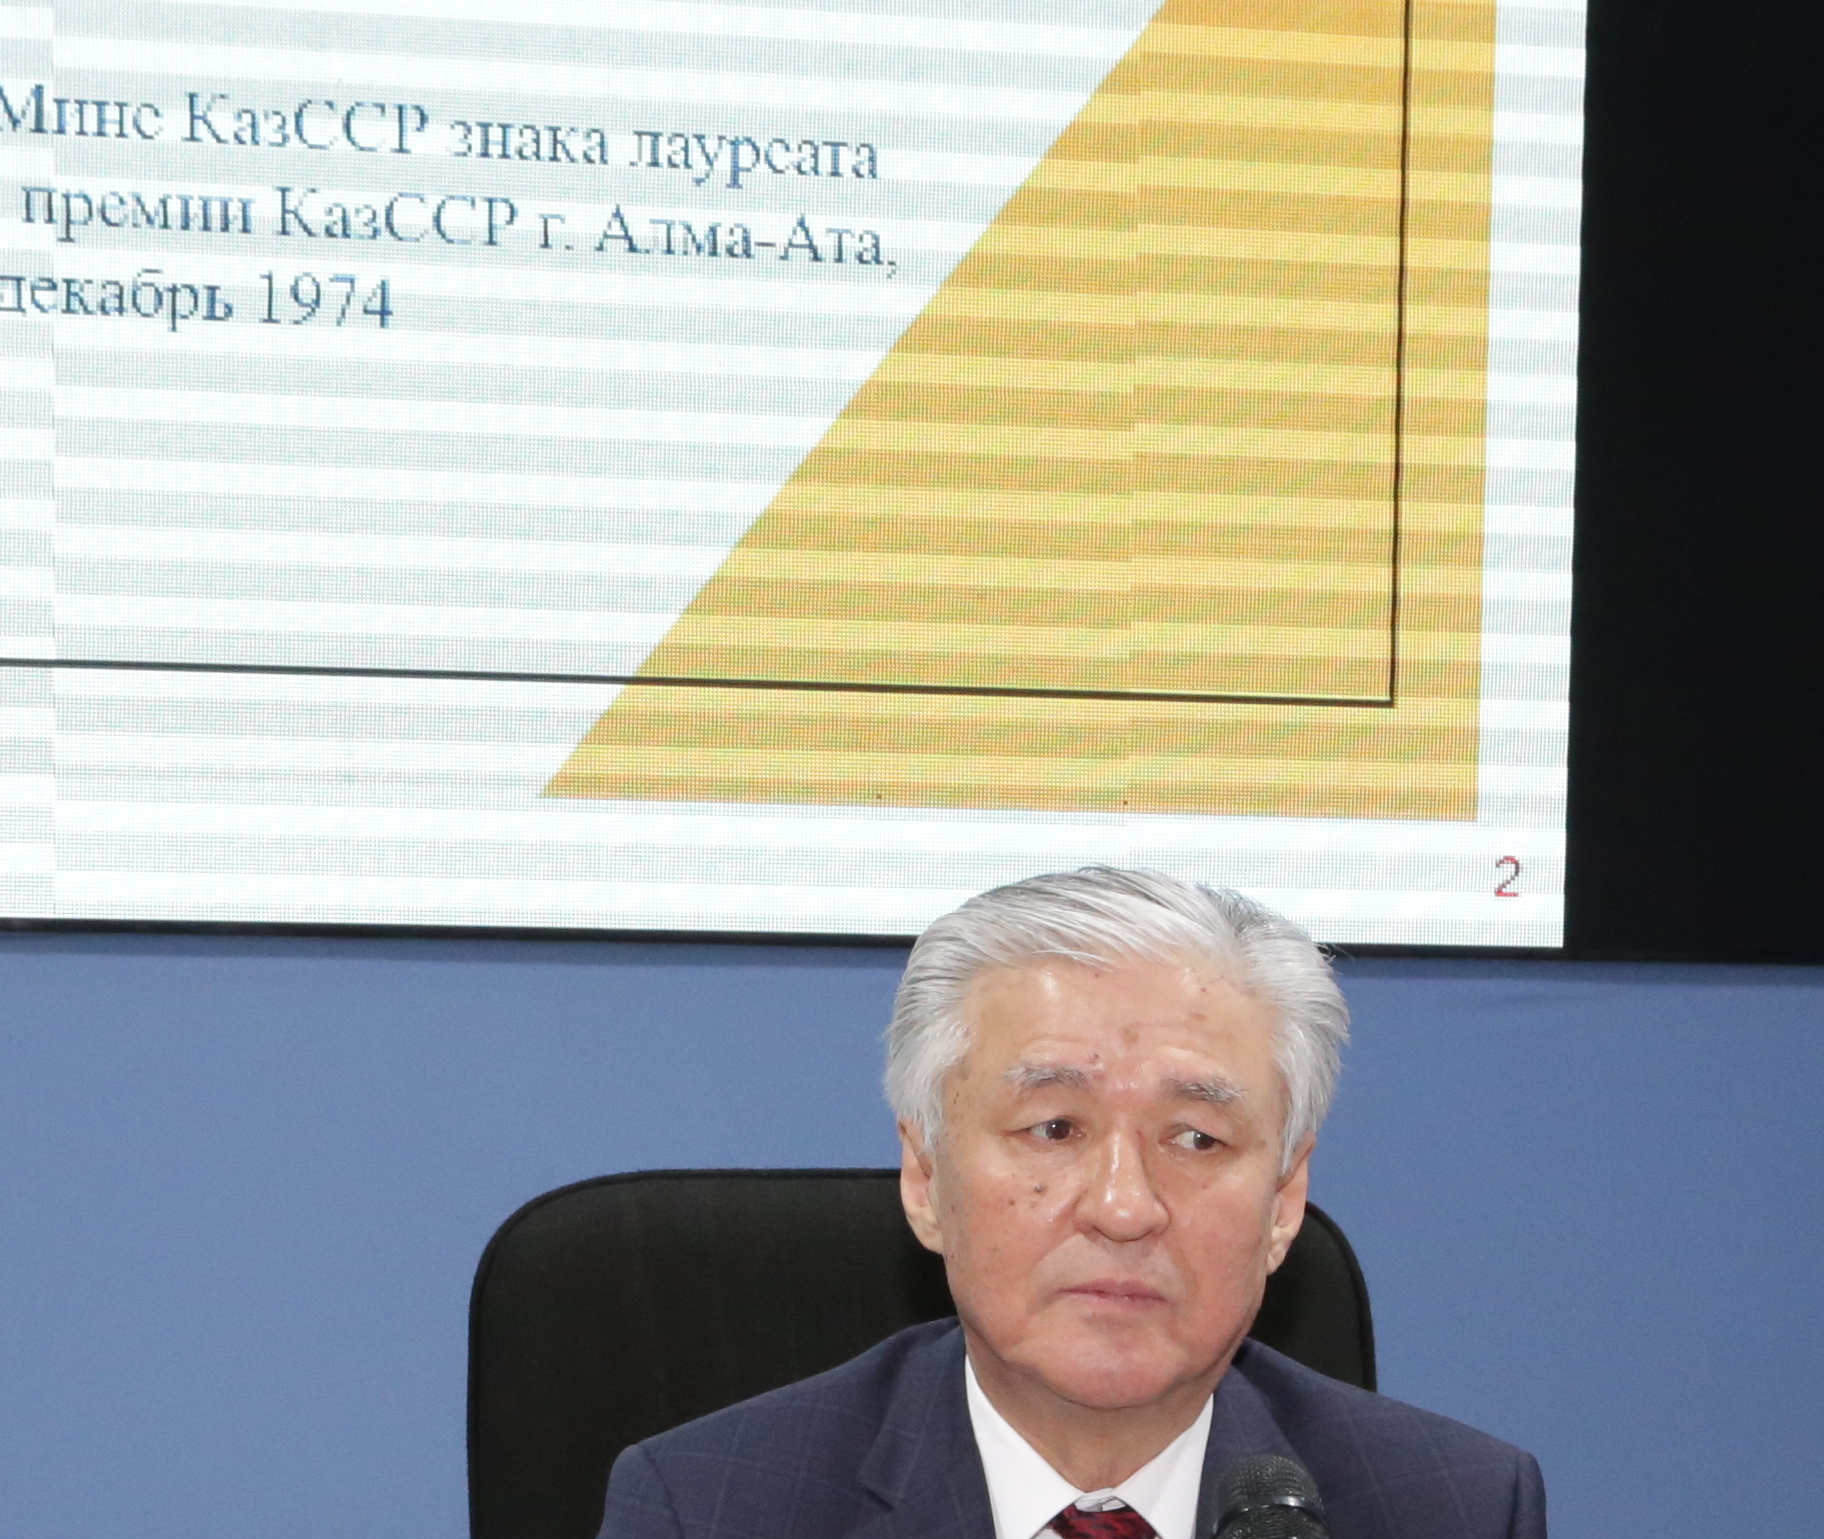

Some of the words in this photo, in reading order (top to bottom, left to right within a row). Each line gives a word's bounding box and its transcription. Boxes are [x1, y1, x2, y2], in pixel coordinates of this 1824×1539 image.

[181, 91, 429, 154] КазССР
[448, 119, 608, 165] знака
[629, 129, 878, 189] лауреата
[21, 185, 256, 242] премии
[273, 186, 519, 246] КазССР
[539, 213, 574, 251] г.
[594, 204, 896, 279] Алма-Ата,
[259, 269, 393, 328] 1974
[1494, 855, 1521, 897] 2
